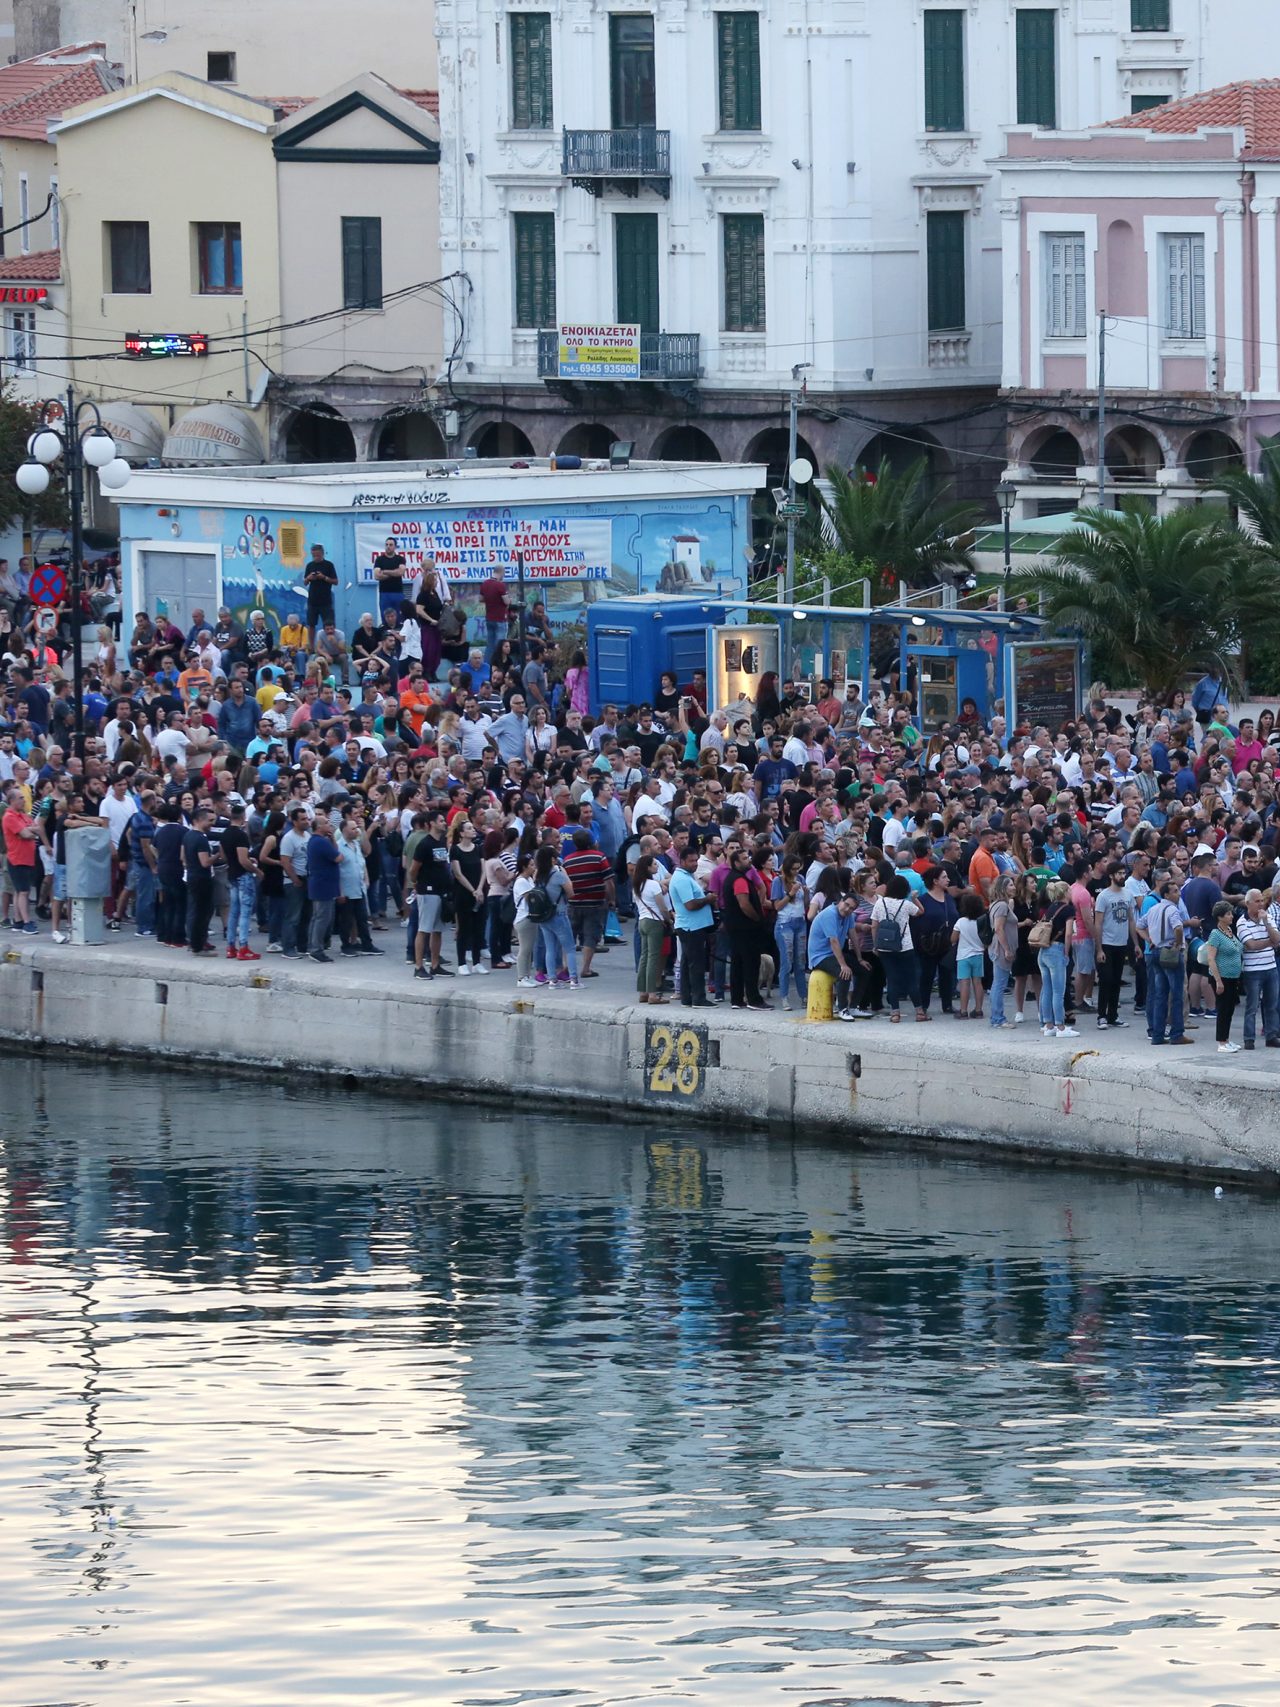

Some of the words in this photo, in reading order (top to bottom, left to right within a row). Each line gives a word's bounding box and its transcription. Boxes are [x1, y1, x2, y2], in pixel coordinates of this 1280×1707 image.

[561, 326, 637, 337] ΕΝΟΙΚΙΑΖΕΤΑΙ
[566, 338, 583, 346] ΟΛΟ
[589, 338, 599, 346] ΤΟ
[580, 364, 601, 373] 6945
[604, 364, 637, 373] 935806
[392, 522, 421, 534] ΟΛΟΙ
[427, 522, 449, 534] ΚΑΙ
[453, 521, 484, 533] ΟΛΕΣ
[486, 521, 518, 532] ΤΡΙΤΗ
[540, 520, 567, 531] ΜΑΗ
[424, 537, 434, 549] 11
[435, 536, 452, 548] ΤΟ
[514, 533, 571, 549] ΣΑΠΦΟΥΣ
[435, 551, 458, 562] ΜΑΗ
[460, 550, 487, 562] ΣΤΙΣ
[488, 550, 496, 562] 5
[496, 549, 510, 561] ΤΟ
[587, 567, 608, 578] ΠΕΚ
[650, 1026, 700, 1094] 28
